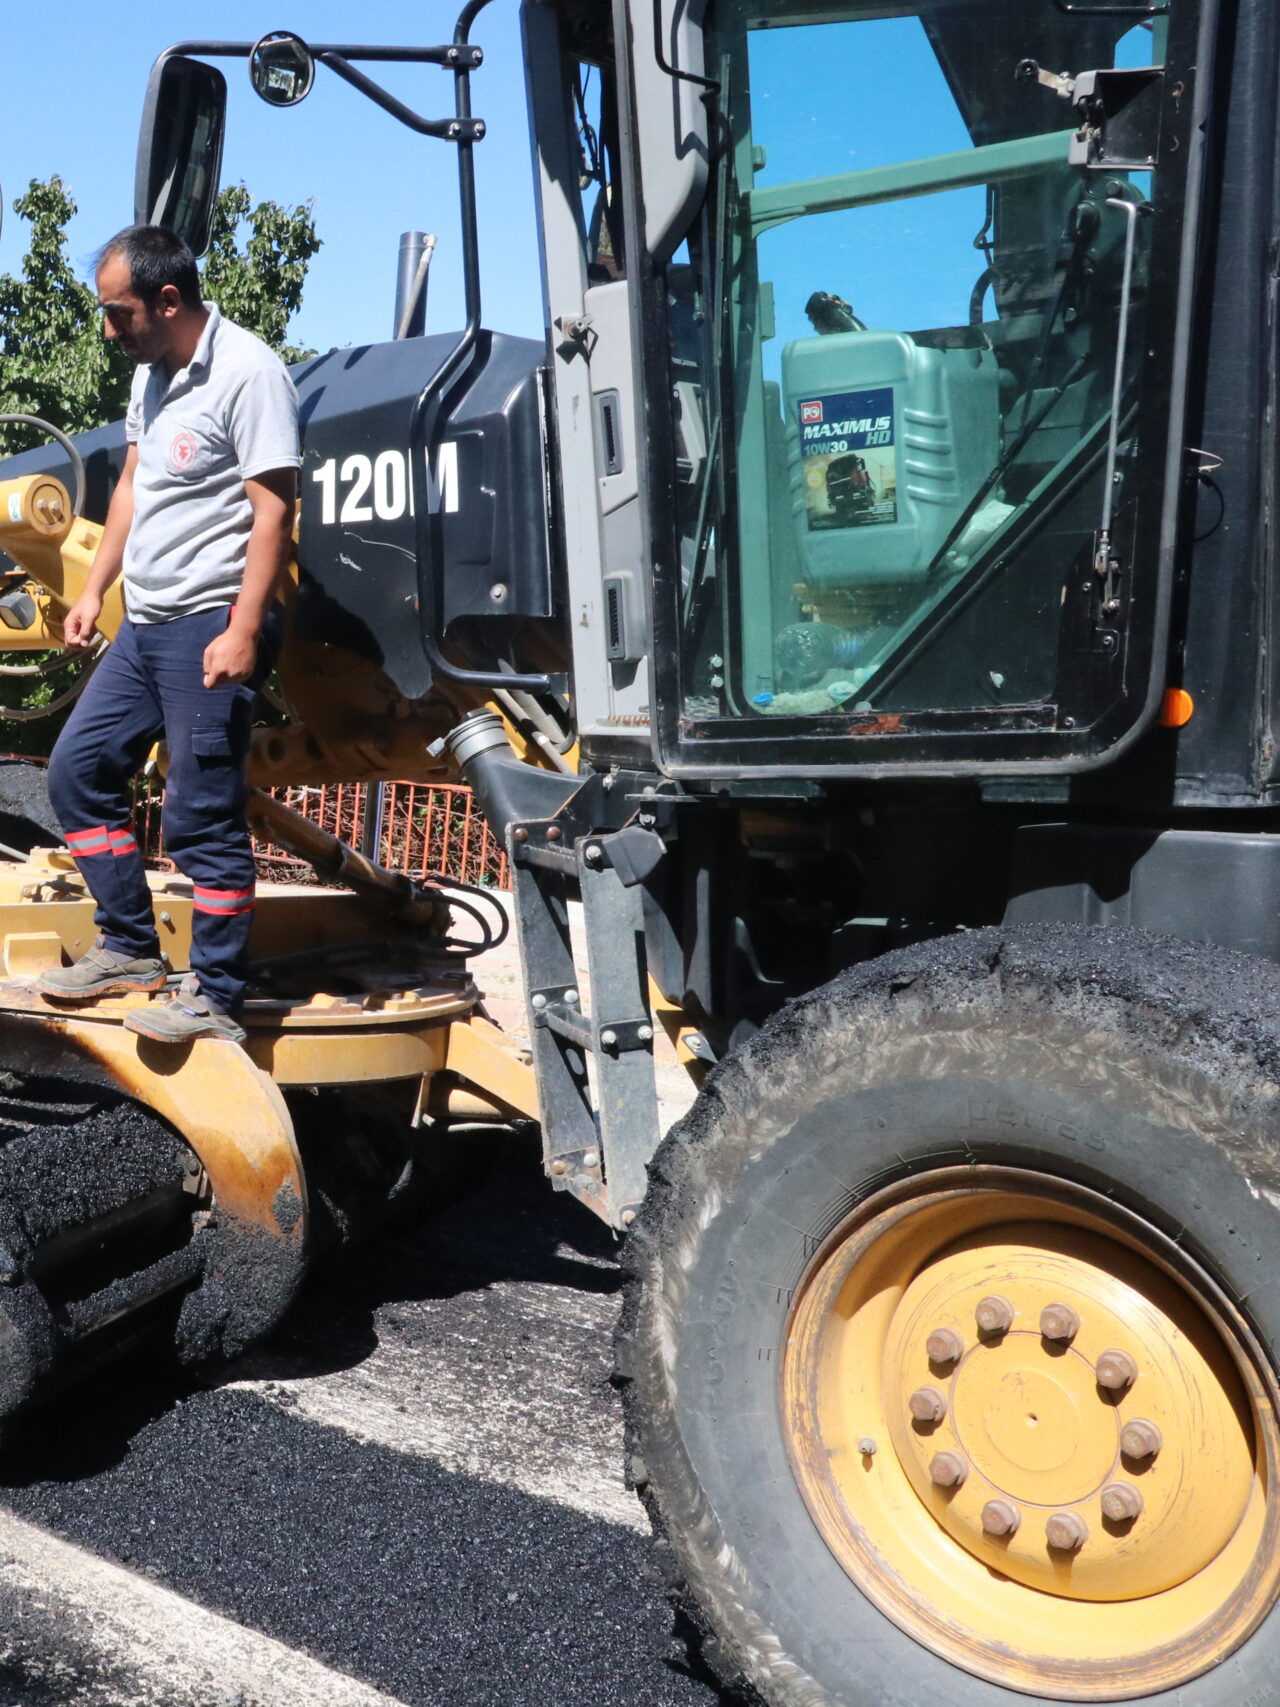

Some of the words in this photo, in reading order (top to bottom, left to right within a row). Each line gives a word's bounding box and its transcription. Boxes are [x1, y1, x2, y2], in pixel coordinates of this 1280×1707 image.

[804, 416, 891, 439] MAXIMUS
[865, 430, 891, 446] HD
[804, 440, 848, 457] 10W30
[312, 441, 459, 525] 120M
